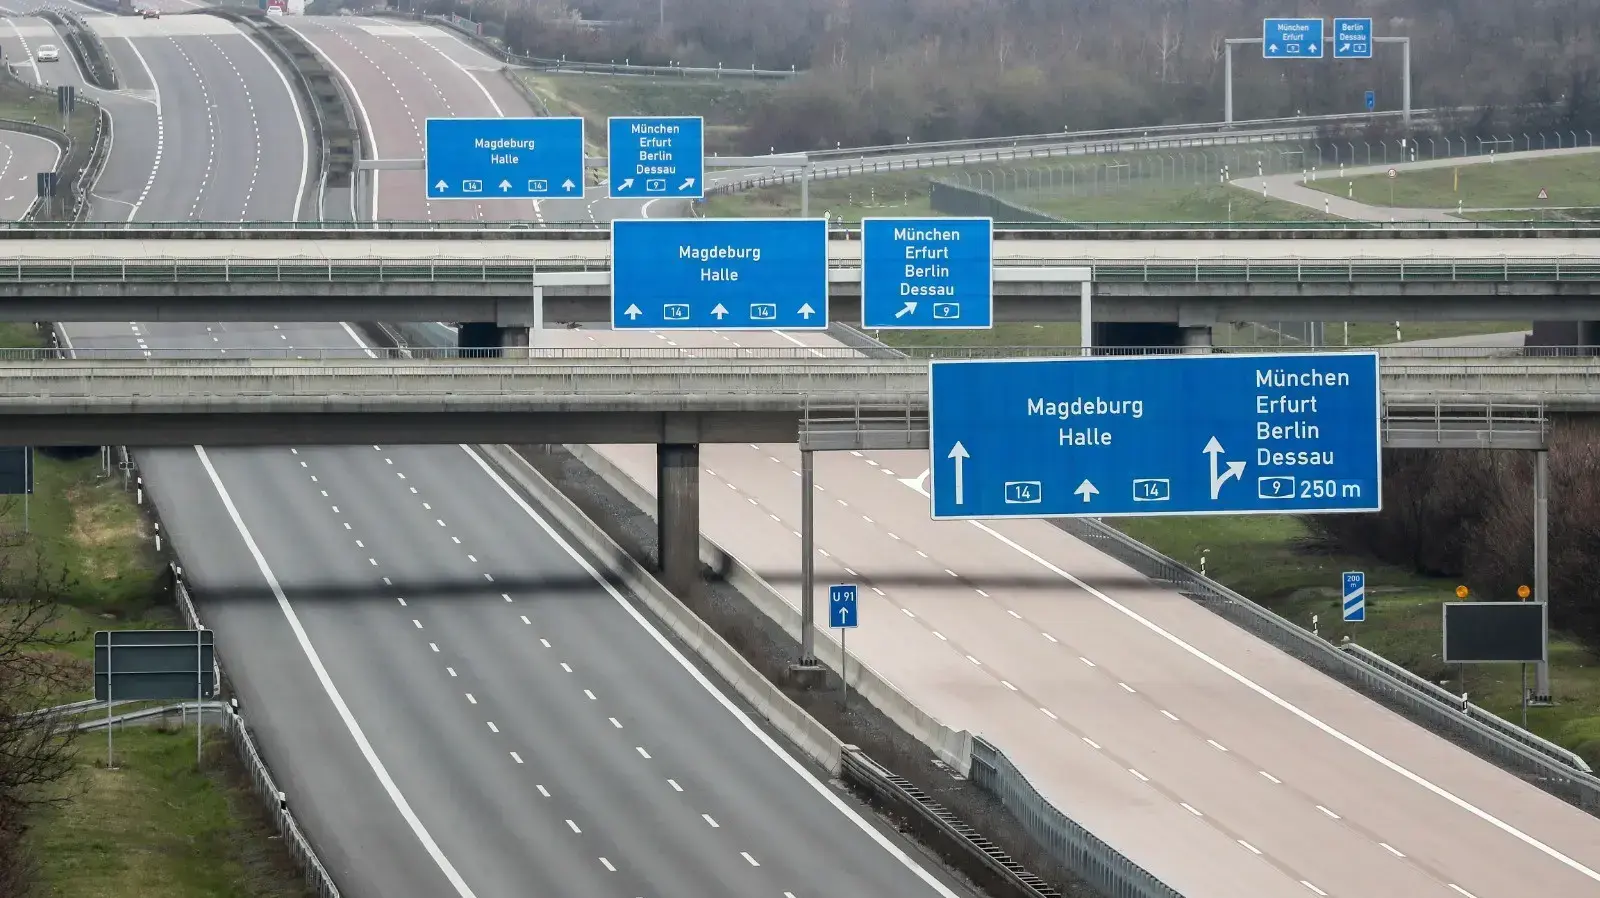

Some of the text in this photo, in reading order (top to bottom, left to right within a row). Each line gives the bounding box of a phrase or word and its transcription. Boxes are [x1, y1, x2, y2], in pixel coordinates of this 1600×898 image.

[632, 124, 679, 133] München
[475, 138, 534, 150] Magdeburg
[640, 137, 671, 147] Erfurt
[492, 154, 518, 163] Halle
[640, 151, 672, 160] Berlin
[637, 165, 675, 174] Dessau
[468, 181, 477, 190] 14
[533, 181, 542, 190] 14
[653, 181, 659, 189] 9
[895, 228, 959, 240] München
[680, 246, 760, 261] Magdeburg
[906, 246, 948, 259] Erfurt
[701, 269, 738, 281] Halle
[906, 265, 948, 277] Berlin
[901, 283, 953, 295] Dessau
[670, 306, 682, 317] 14
[757, 306, 769, 317] 14
[943, 306, 950, 317] 9
[1257, 369, 1348, 387] München
[1028, 397, 1142, 419] Magdeburg
[1257, 395, 1316, 413] Erfurt
[1257, 421, 1318, 439] Berlin
[1060, 428, 1111, 445] Halle
[1258, 448, 1333, 465] Dessau
[1016, 486, 1030, 498] 14
[1144, 484, 1158, 496] 14
[1273, 480, 1360, 498] 9 250 m
[833, 592, 854, 602] U 91
